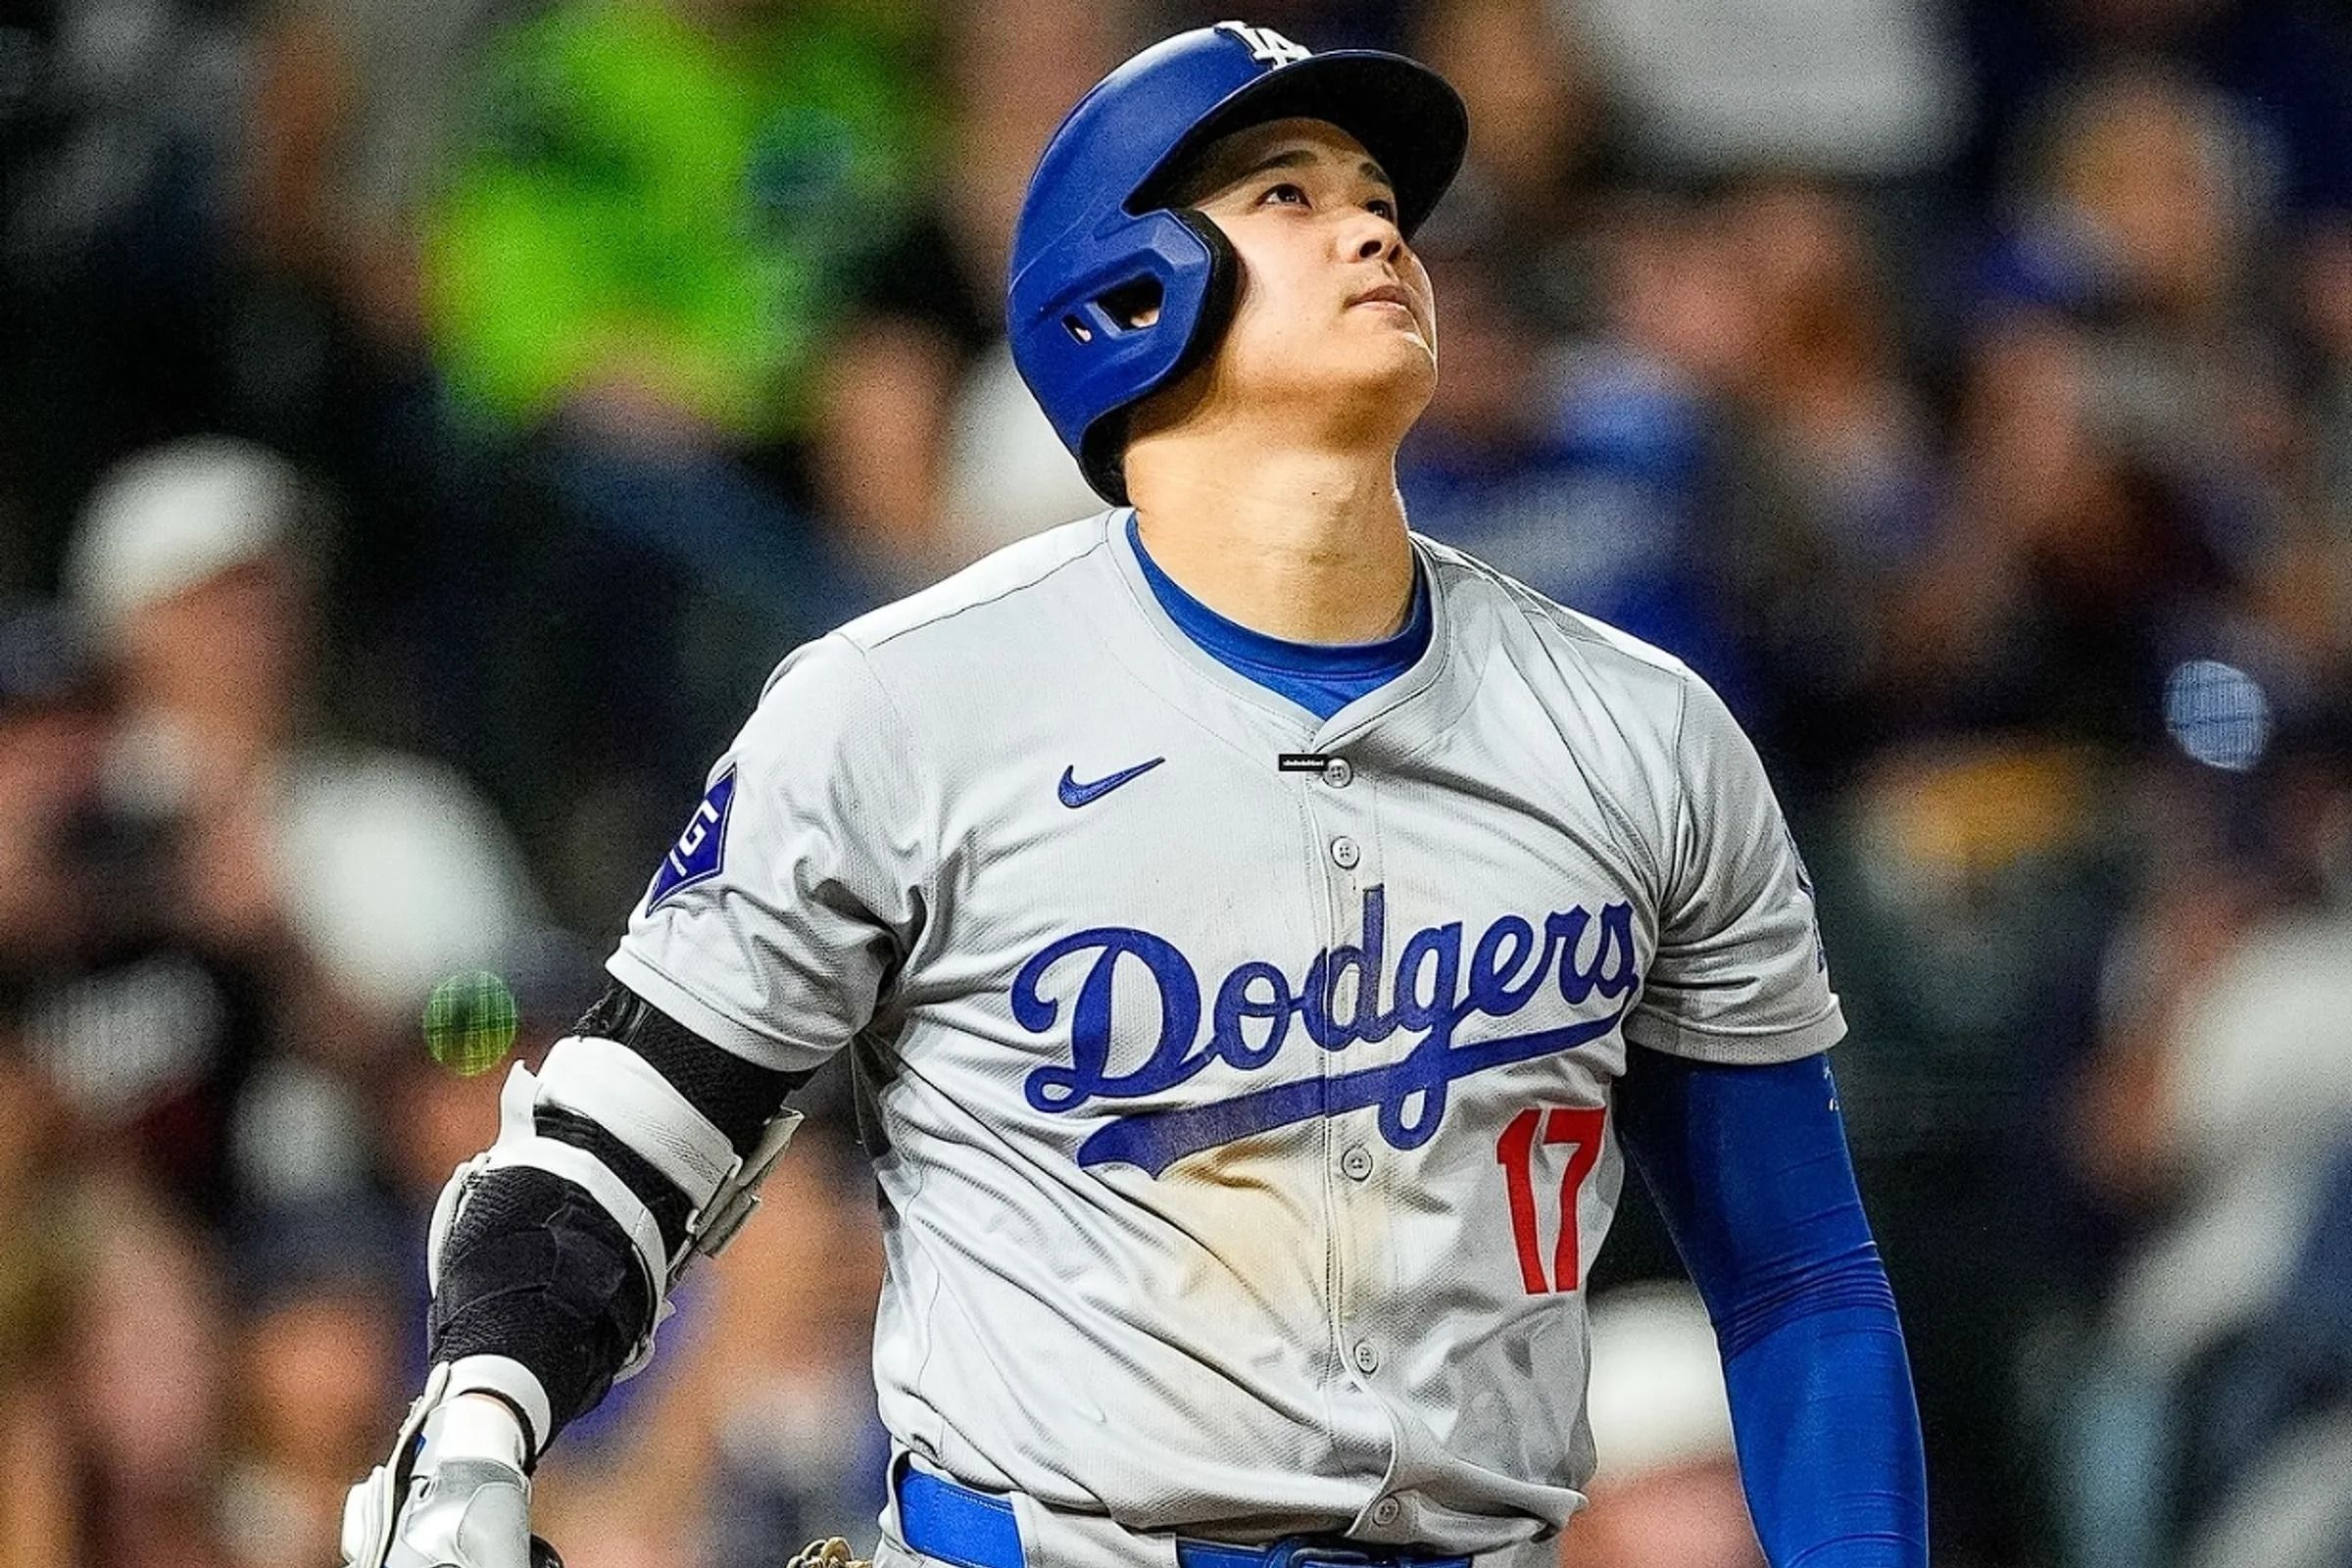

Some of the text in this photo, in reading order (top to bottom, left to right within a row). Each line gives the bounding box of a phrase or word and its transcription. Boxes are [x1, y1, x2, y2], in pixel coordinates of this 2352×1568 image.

[1213, 21, 1314, 71] LA
[1010, 883, 1639, 1152] Dodgers
[1496, 1106, 1606, 1295] 17
